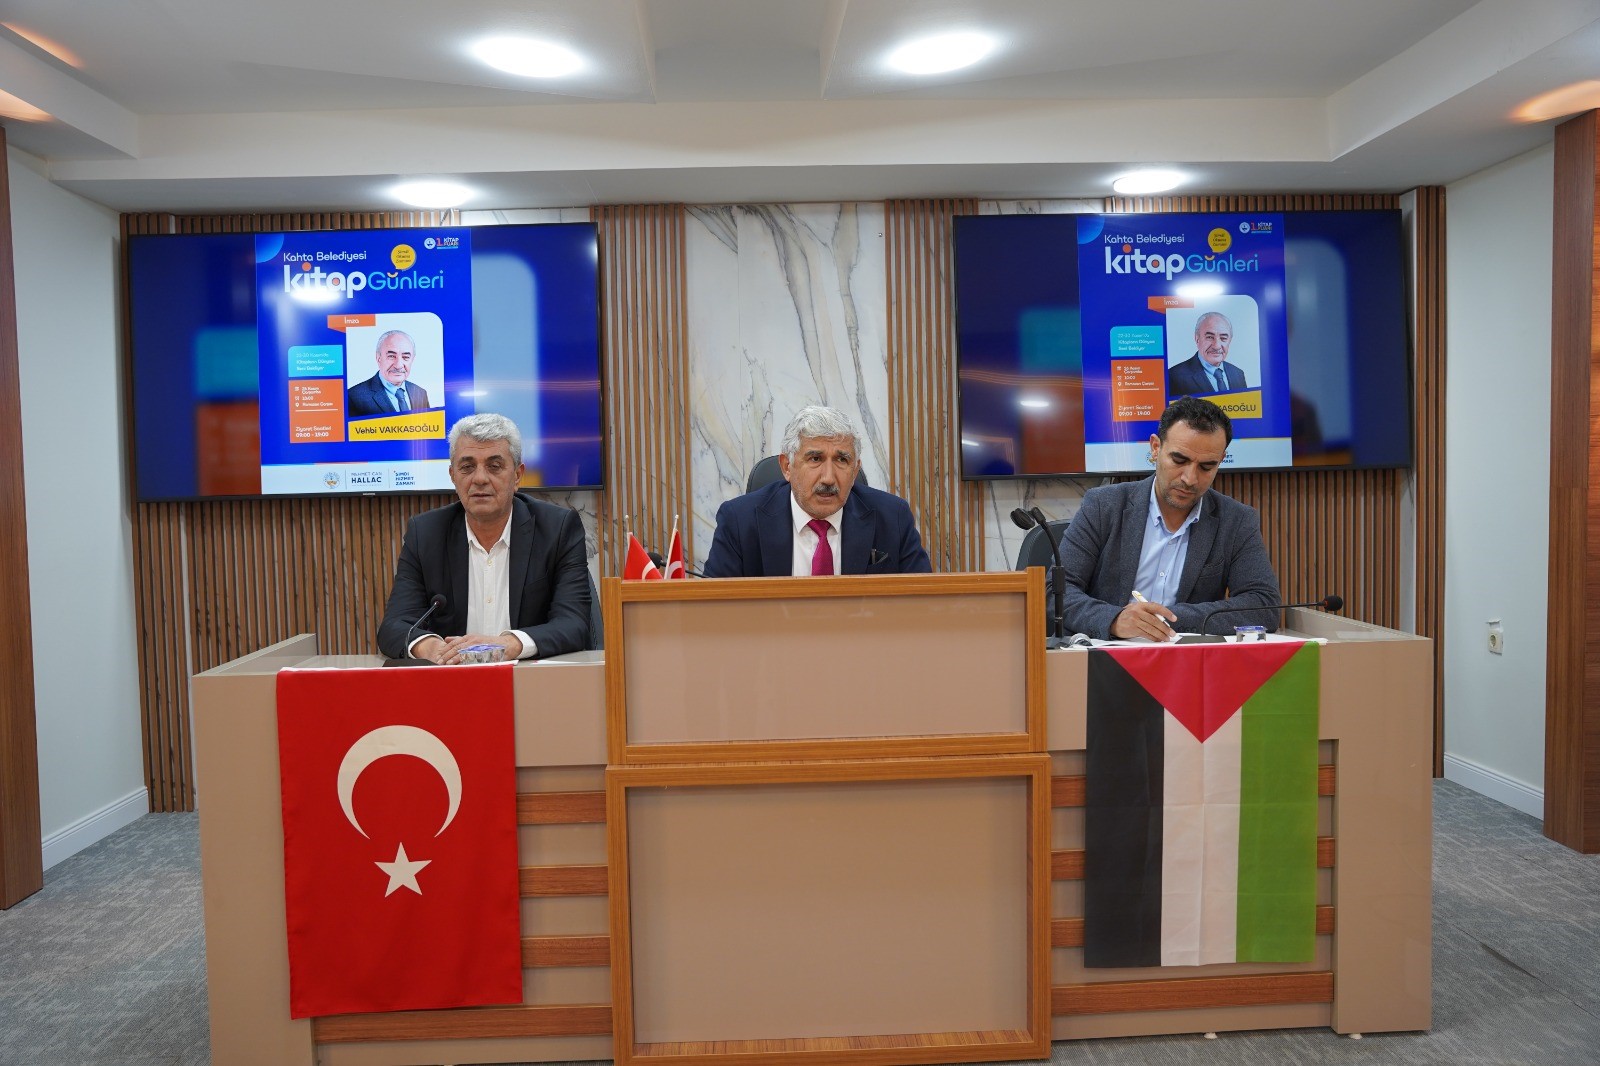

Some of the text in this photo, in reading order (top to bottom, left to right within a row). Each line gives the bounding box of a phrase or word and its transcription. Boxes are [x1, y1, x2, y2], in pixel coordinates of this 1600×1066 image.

[1104, 233, 1185, 244] Kahta Belediyesi
[283, 250, 367, 262] Kahta Belediyesi
[1104, 244, 1185, 280] kitap
[283, 262, 367, 299] kitap
[355, 423, 440, 435] Vehbi VAKKASOĞLU
